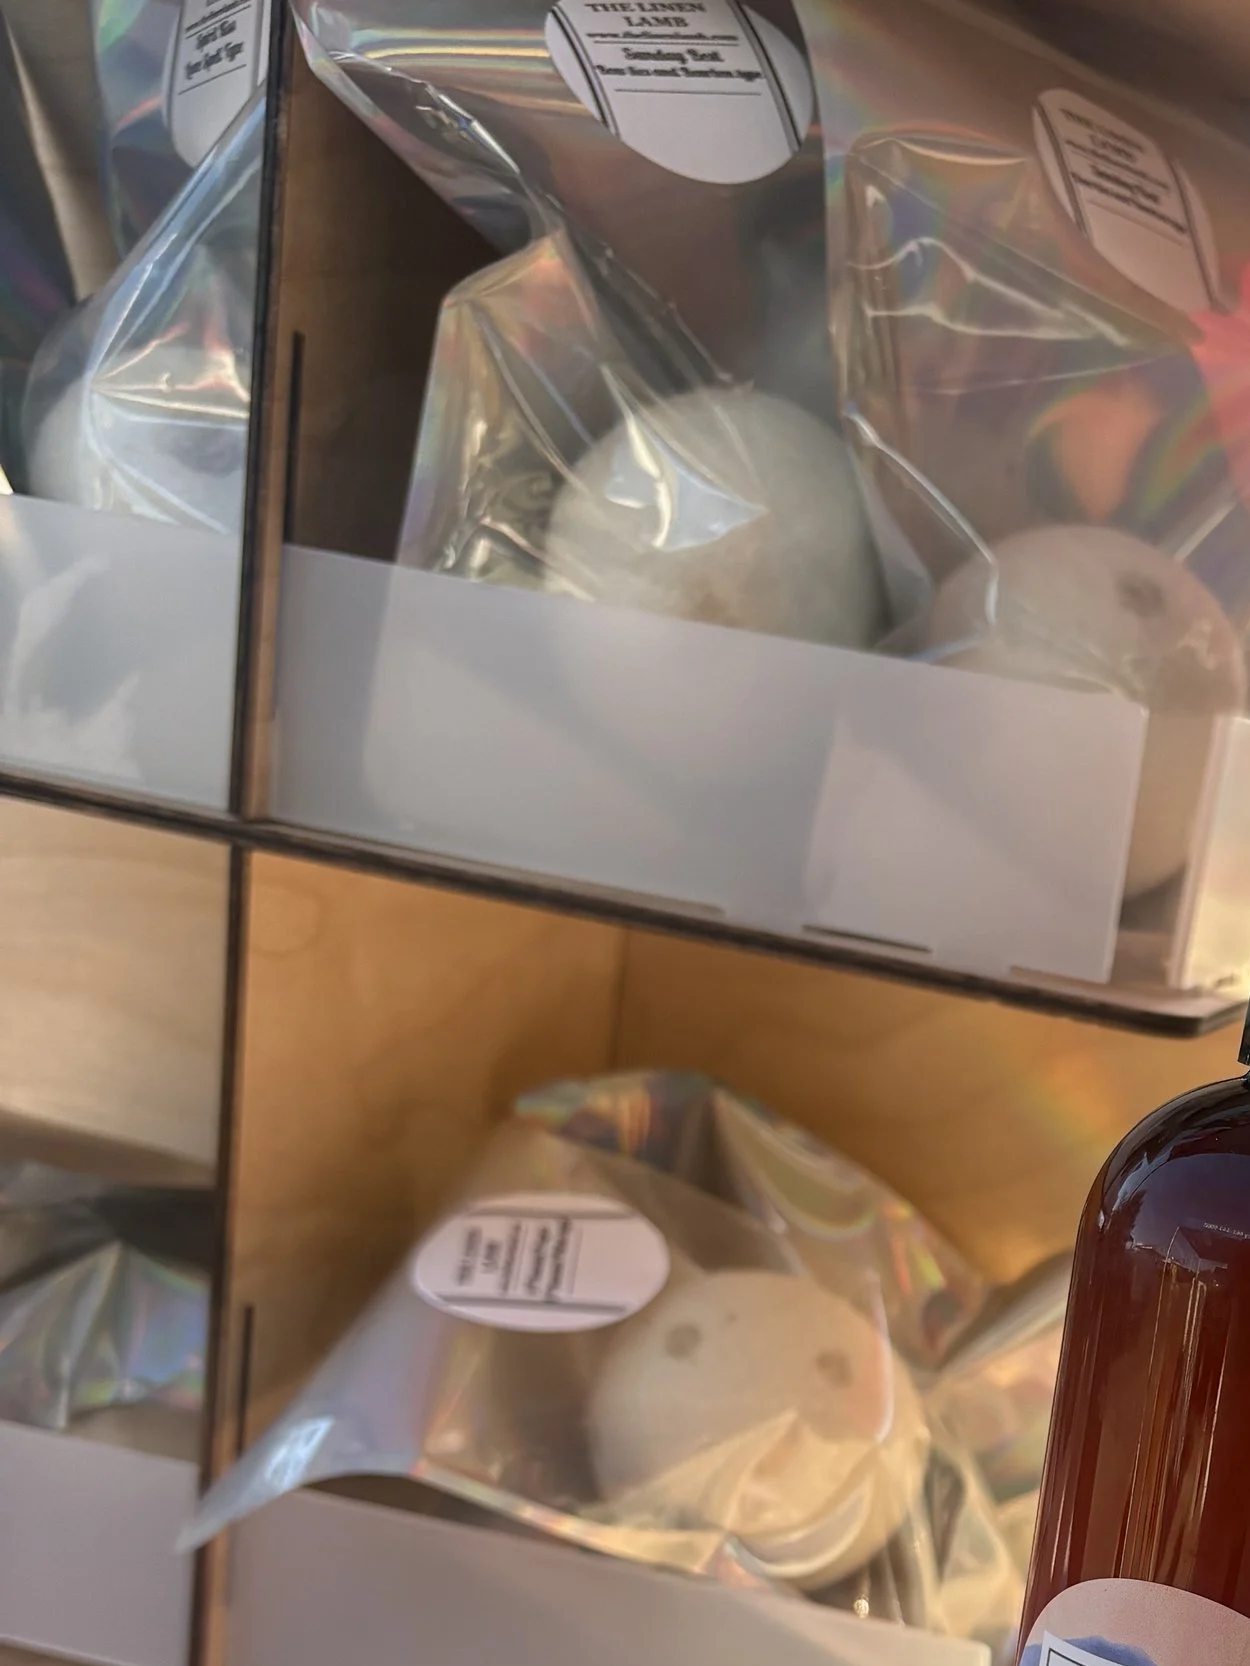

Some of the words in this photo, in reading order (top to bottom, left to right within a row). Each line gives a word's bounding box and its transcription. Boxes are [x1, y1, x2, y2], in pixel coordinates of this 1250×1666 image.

[584, 3, 638, 13] THE
[634, 3, 706, 13] LINEN
[622, 16, 690, 28] LAMB
